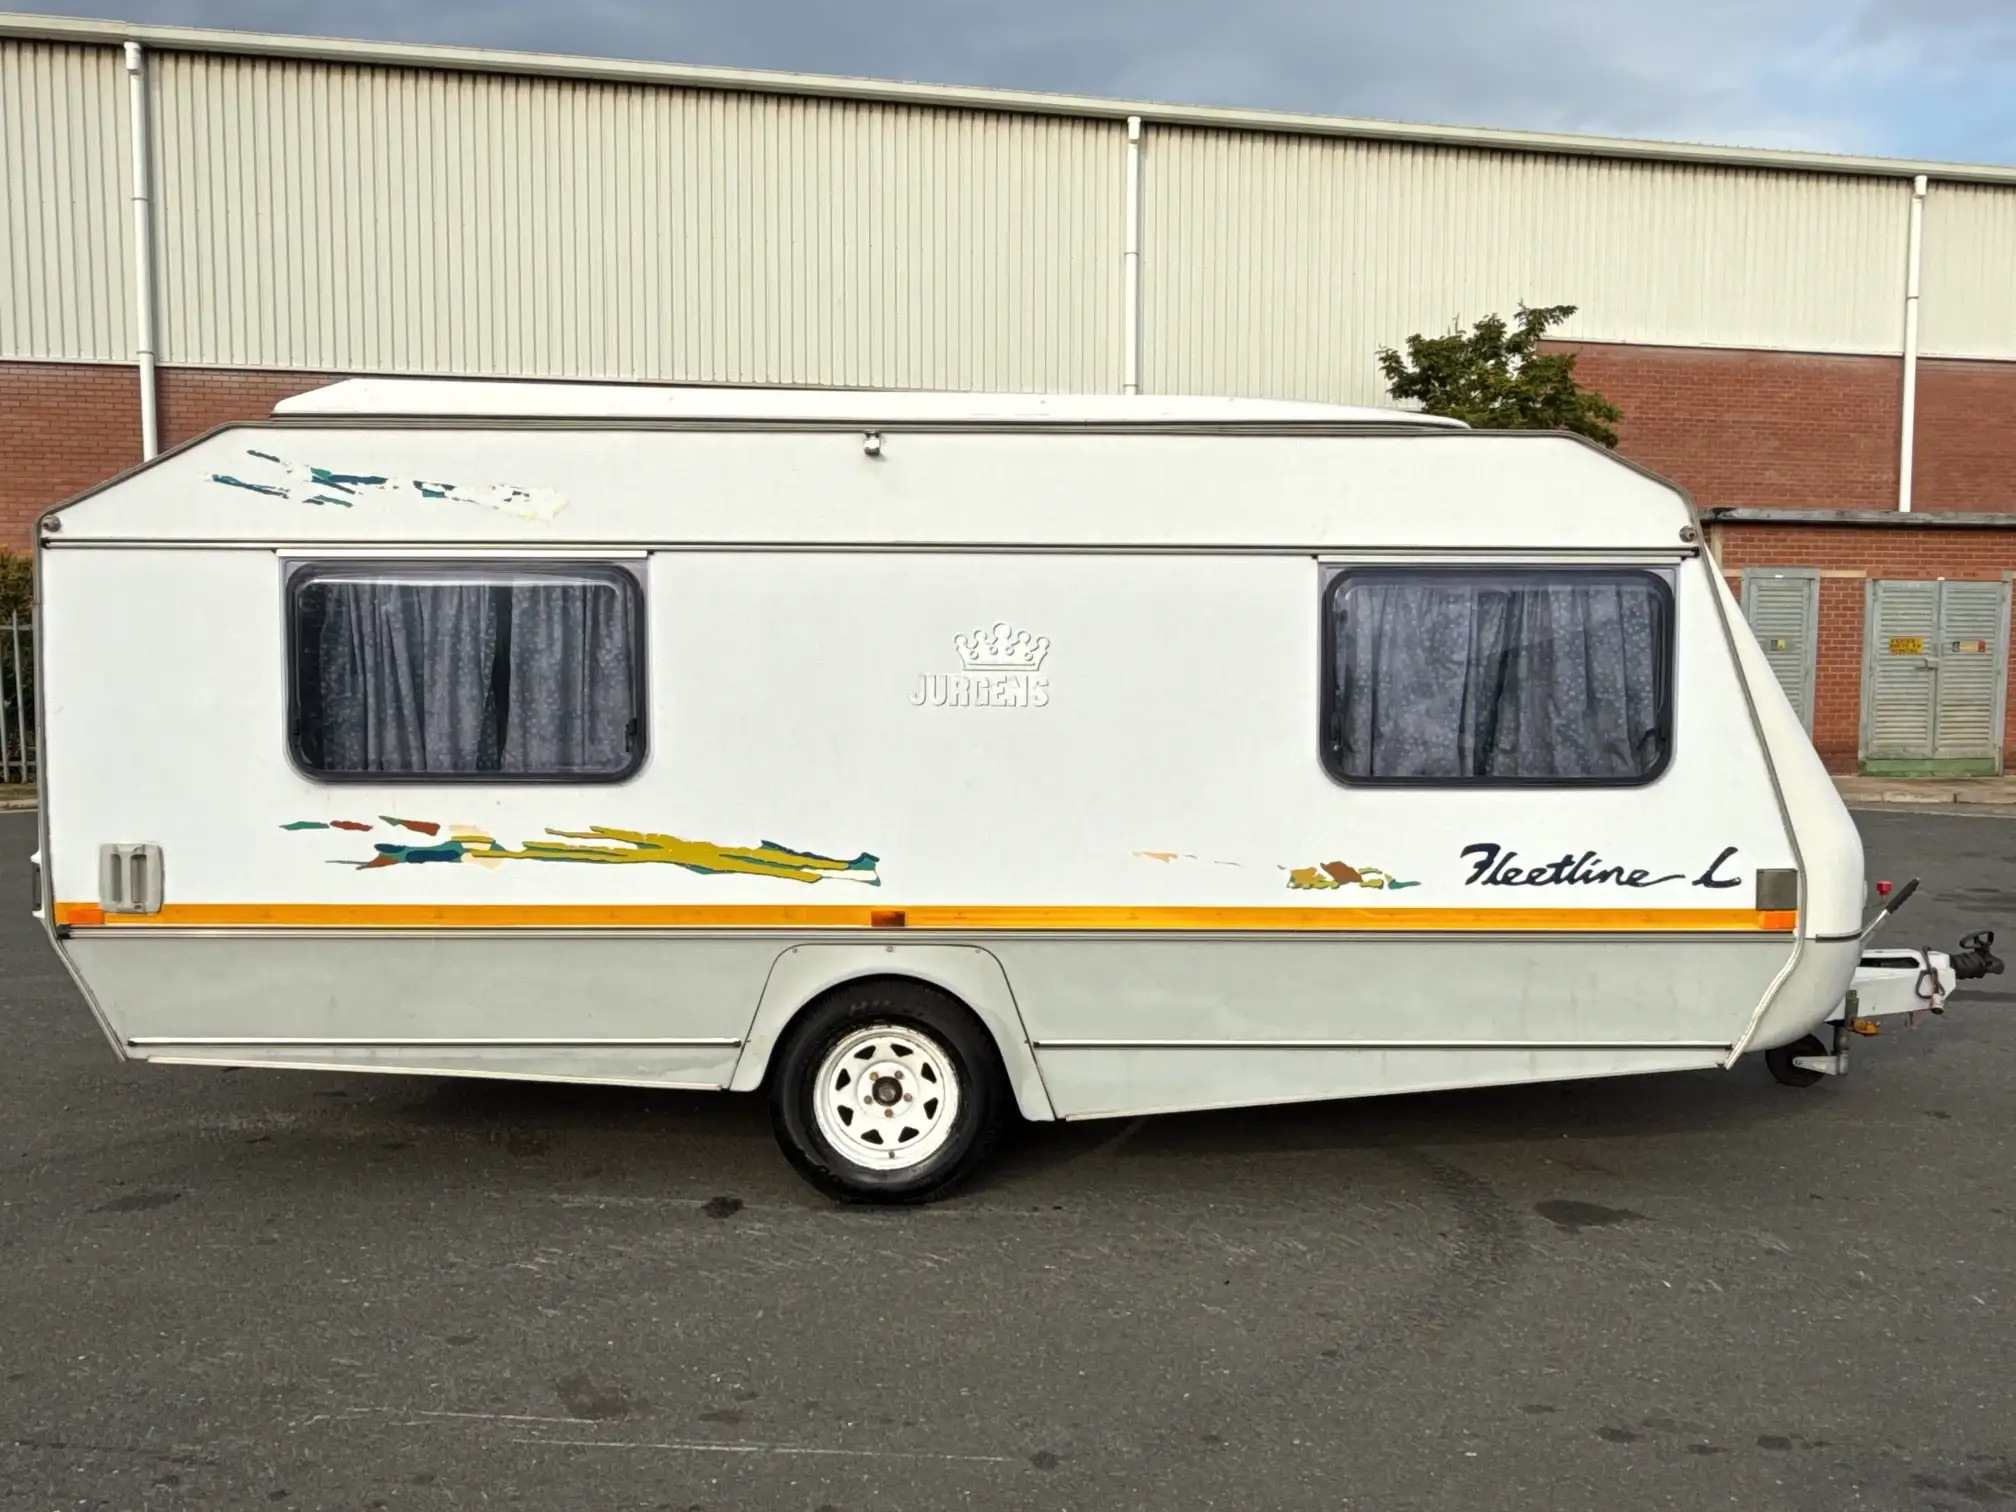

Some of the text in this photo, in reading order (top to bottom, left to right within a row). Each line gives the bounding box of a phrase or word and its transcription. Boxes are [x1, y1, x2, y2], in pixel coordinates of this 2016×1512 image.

[909, 673, 1050, 708] JURGENS
[1460, 842, 1743, 889] Fleetline L
